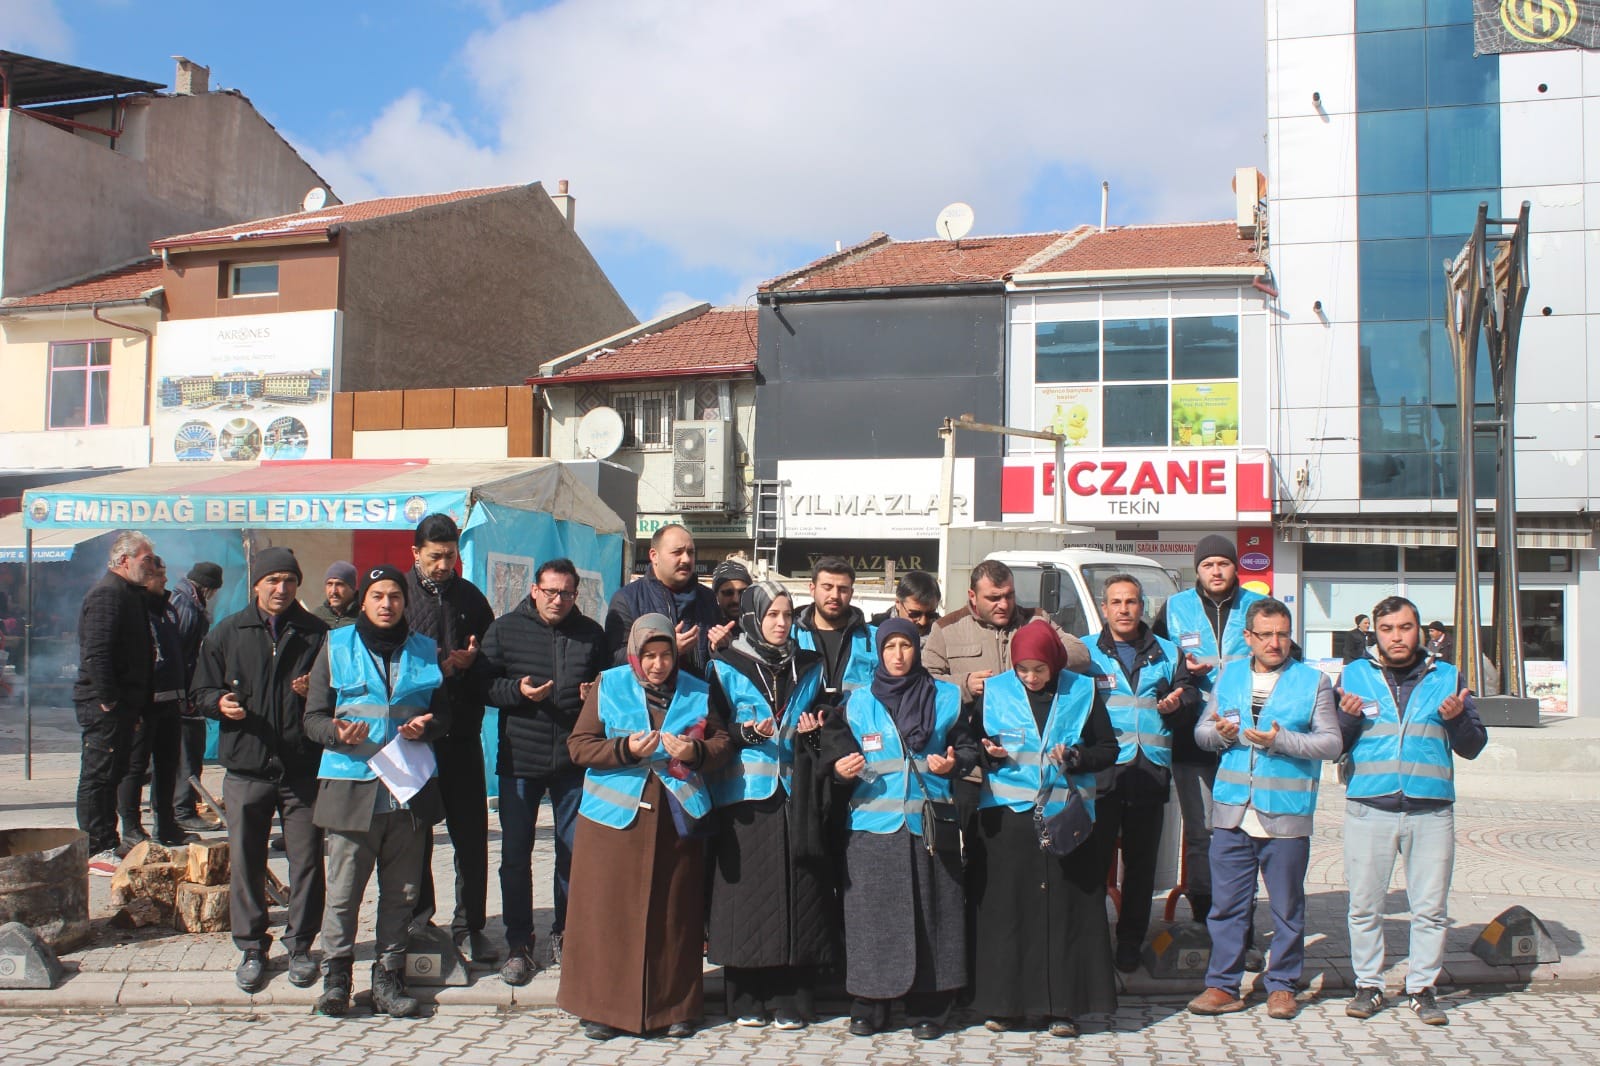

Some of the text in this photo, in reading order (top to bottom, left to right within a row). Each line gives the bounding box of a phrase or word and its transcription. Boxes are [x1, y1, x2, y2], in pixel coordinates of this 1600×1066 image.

[1043, 460, 1227, 496] ECZANE
[790, 494, 968, 516] YILMAZLAR
[1108, 498, 1160, 514] TEKİN
[1105, 543, 1114, 553] EN
[1115, 543, 1134, 553] YAKIN
[1137, 542, 1196, 554] SAĞLIK DANIŞMANI
